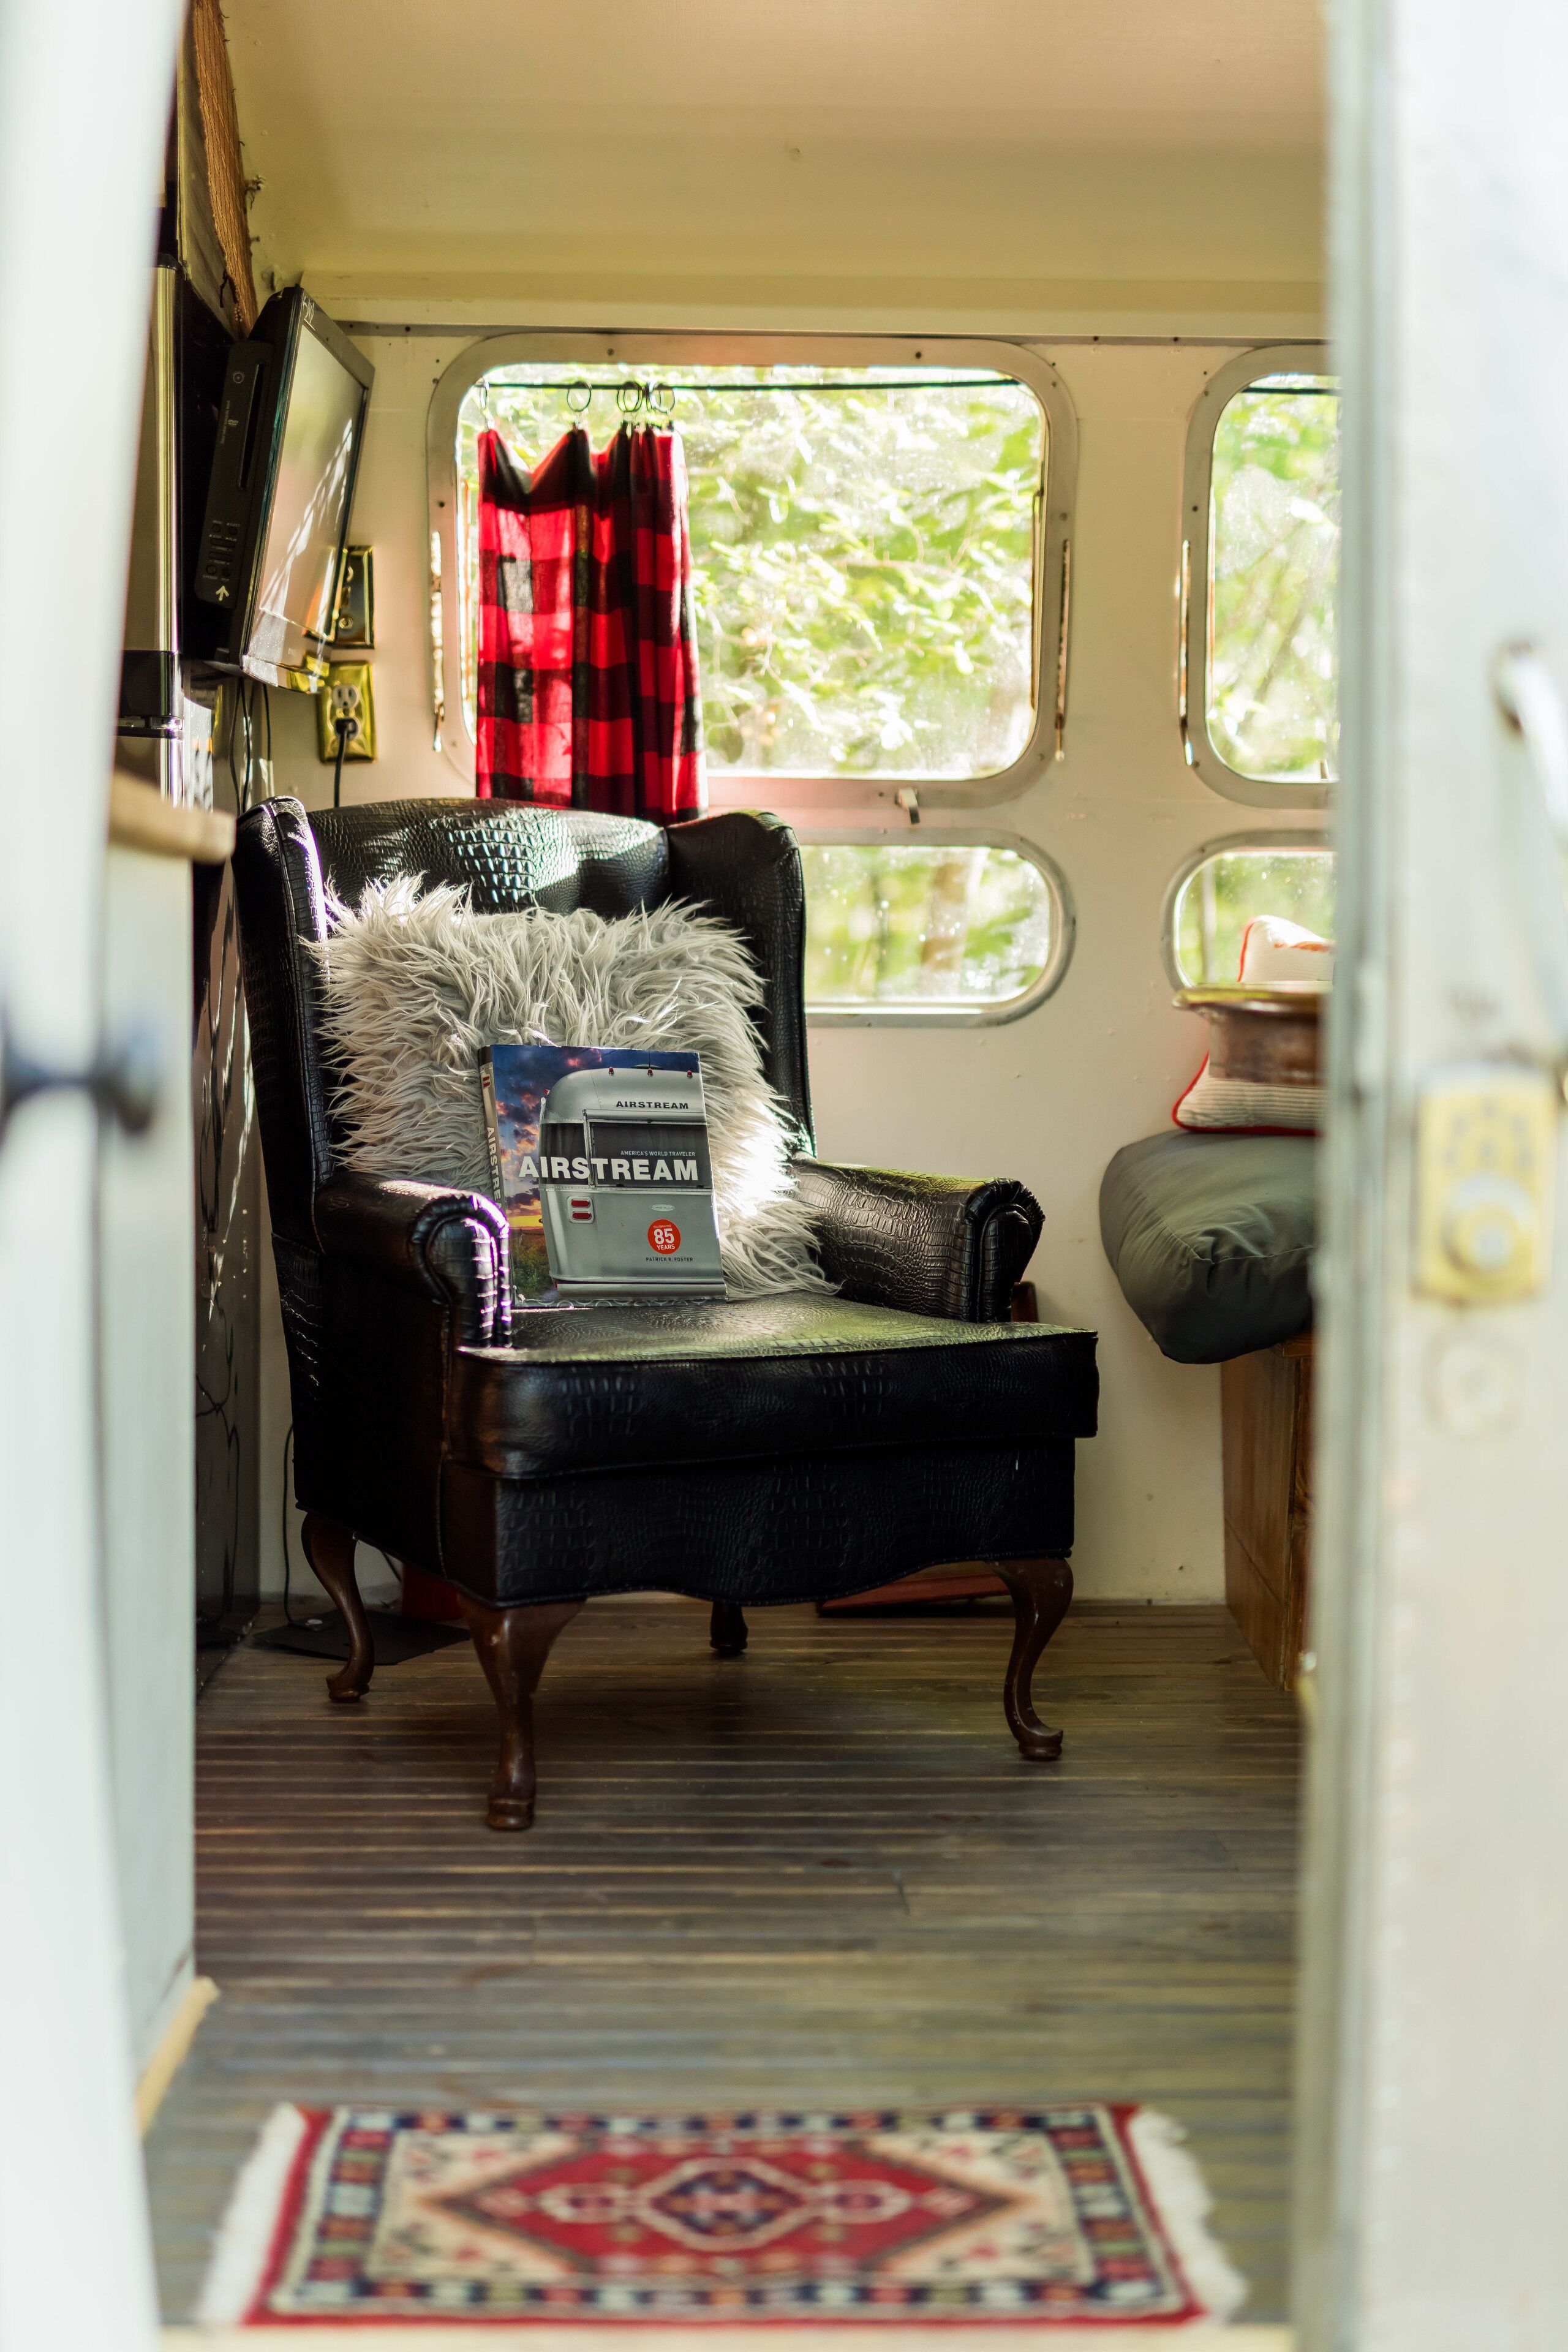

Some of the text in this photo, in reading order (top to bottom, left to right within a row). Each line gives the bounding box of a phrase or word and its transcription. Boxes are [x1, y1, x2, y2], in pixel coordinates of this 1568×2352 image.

[616, 1101, 688, 1109] AIRSTREAM
[487, 1127, 502, 1208] AIRSTRE
[519, 1156, 698, 1181] AIRSTREAM
[654, 1228, 674, 1245] 85
